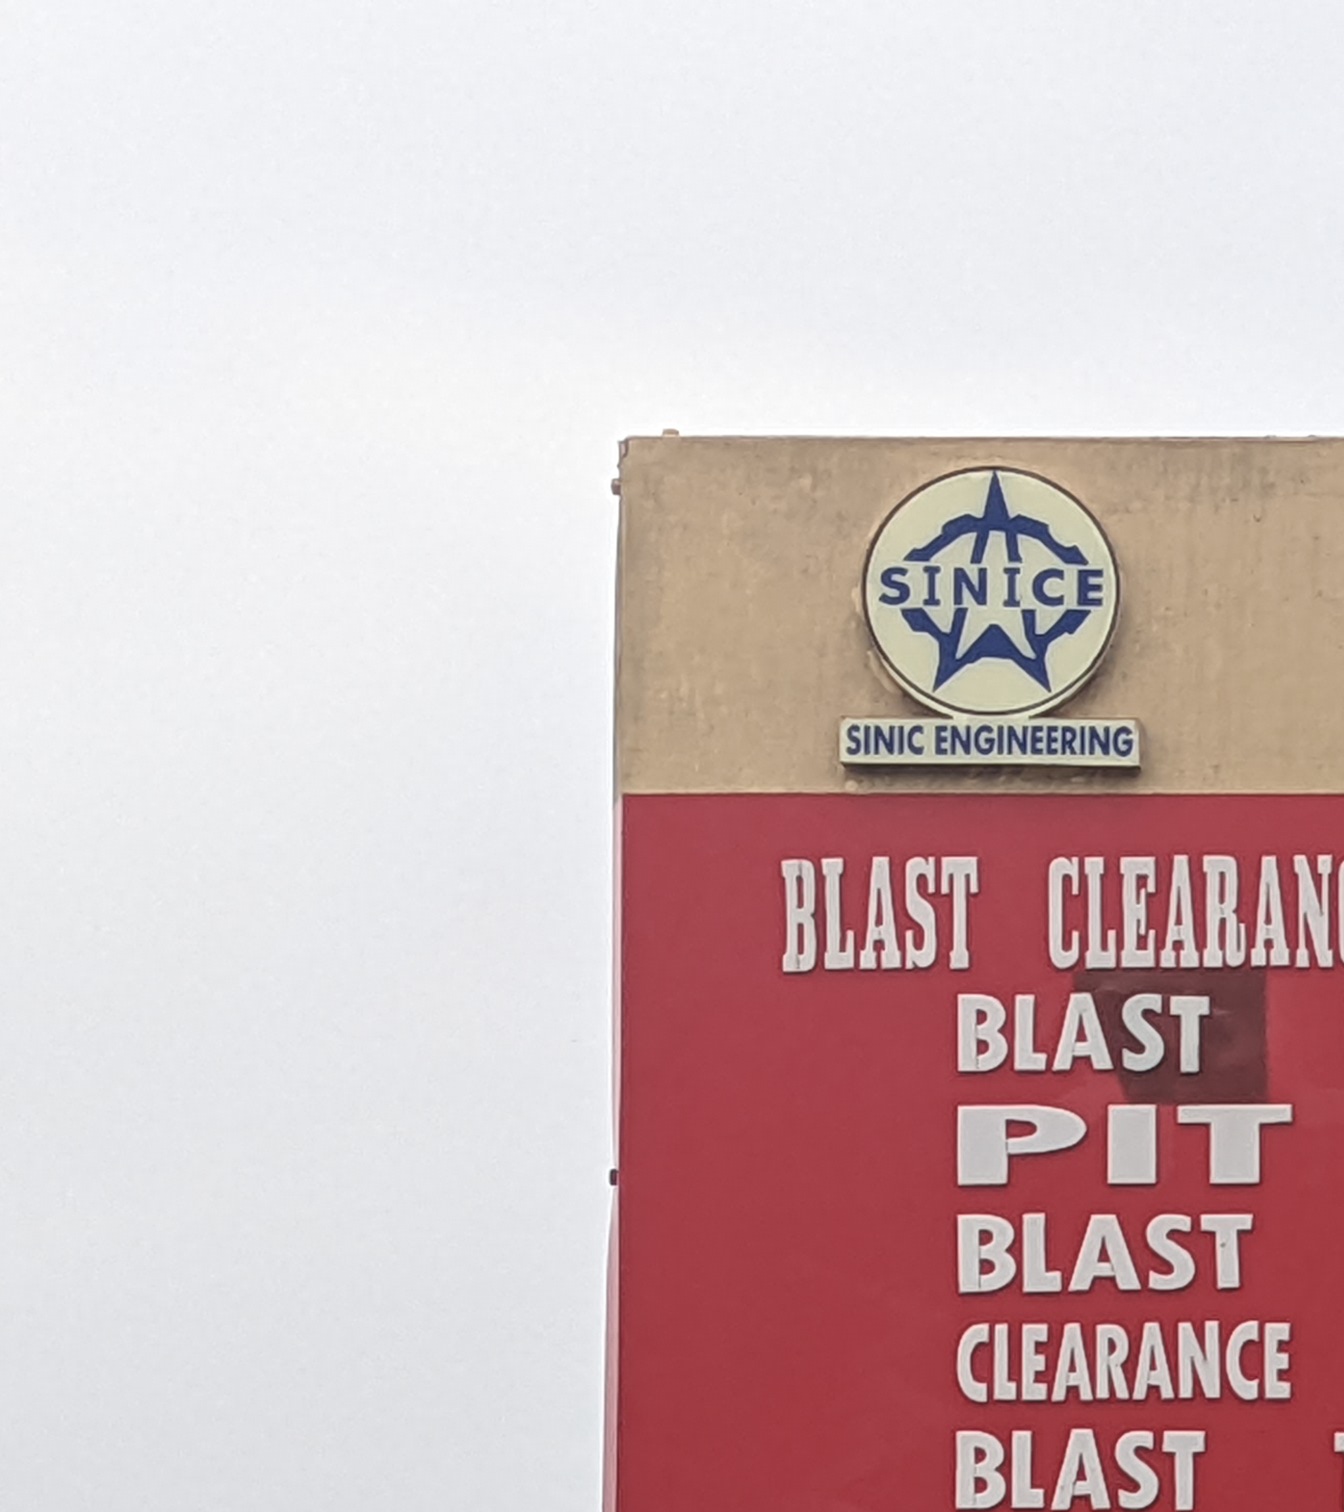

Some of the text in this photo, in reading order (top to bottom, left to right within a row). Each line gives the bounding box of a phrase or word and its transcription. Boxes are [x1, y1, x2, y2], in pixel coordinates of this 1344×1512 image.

[880, 567, 1103, 606] SINICE
[847, 725, 1133, 756] SINIC ENGINEERING
[781, 856, 980, 973] BLAST
[957, 991, 1211, 1074] BLAST
[956, 1103, 1293, 1186] PIT
[957, 1212, 1254, 1294] BLAST
[956, 1320, 1292, 1403] CLEARANCE
[955, 1428, 1206, 1512] BLAST
